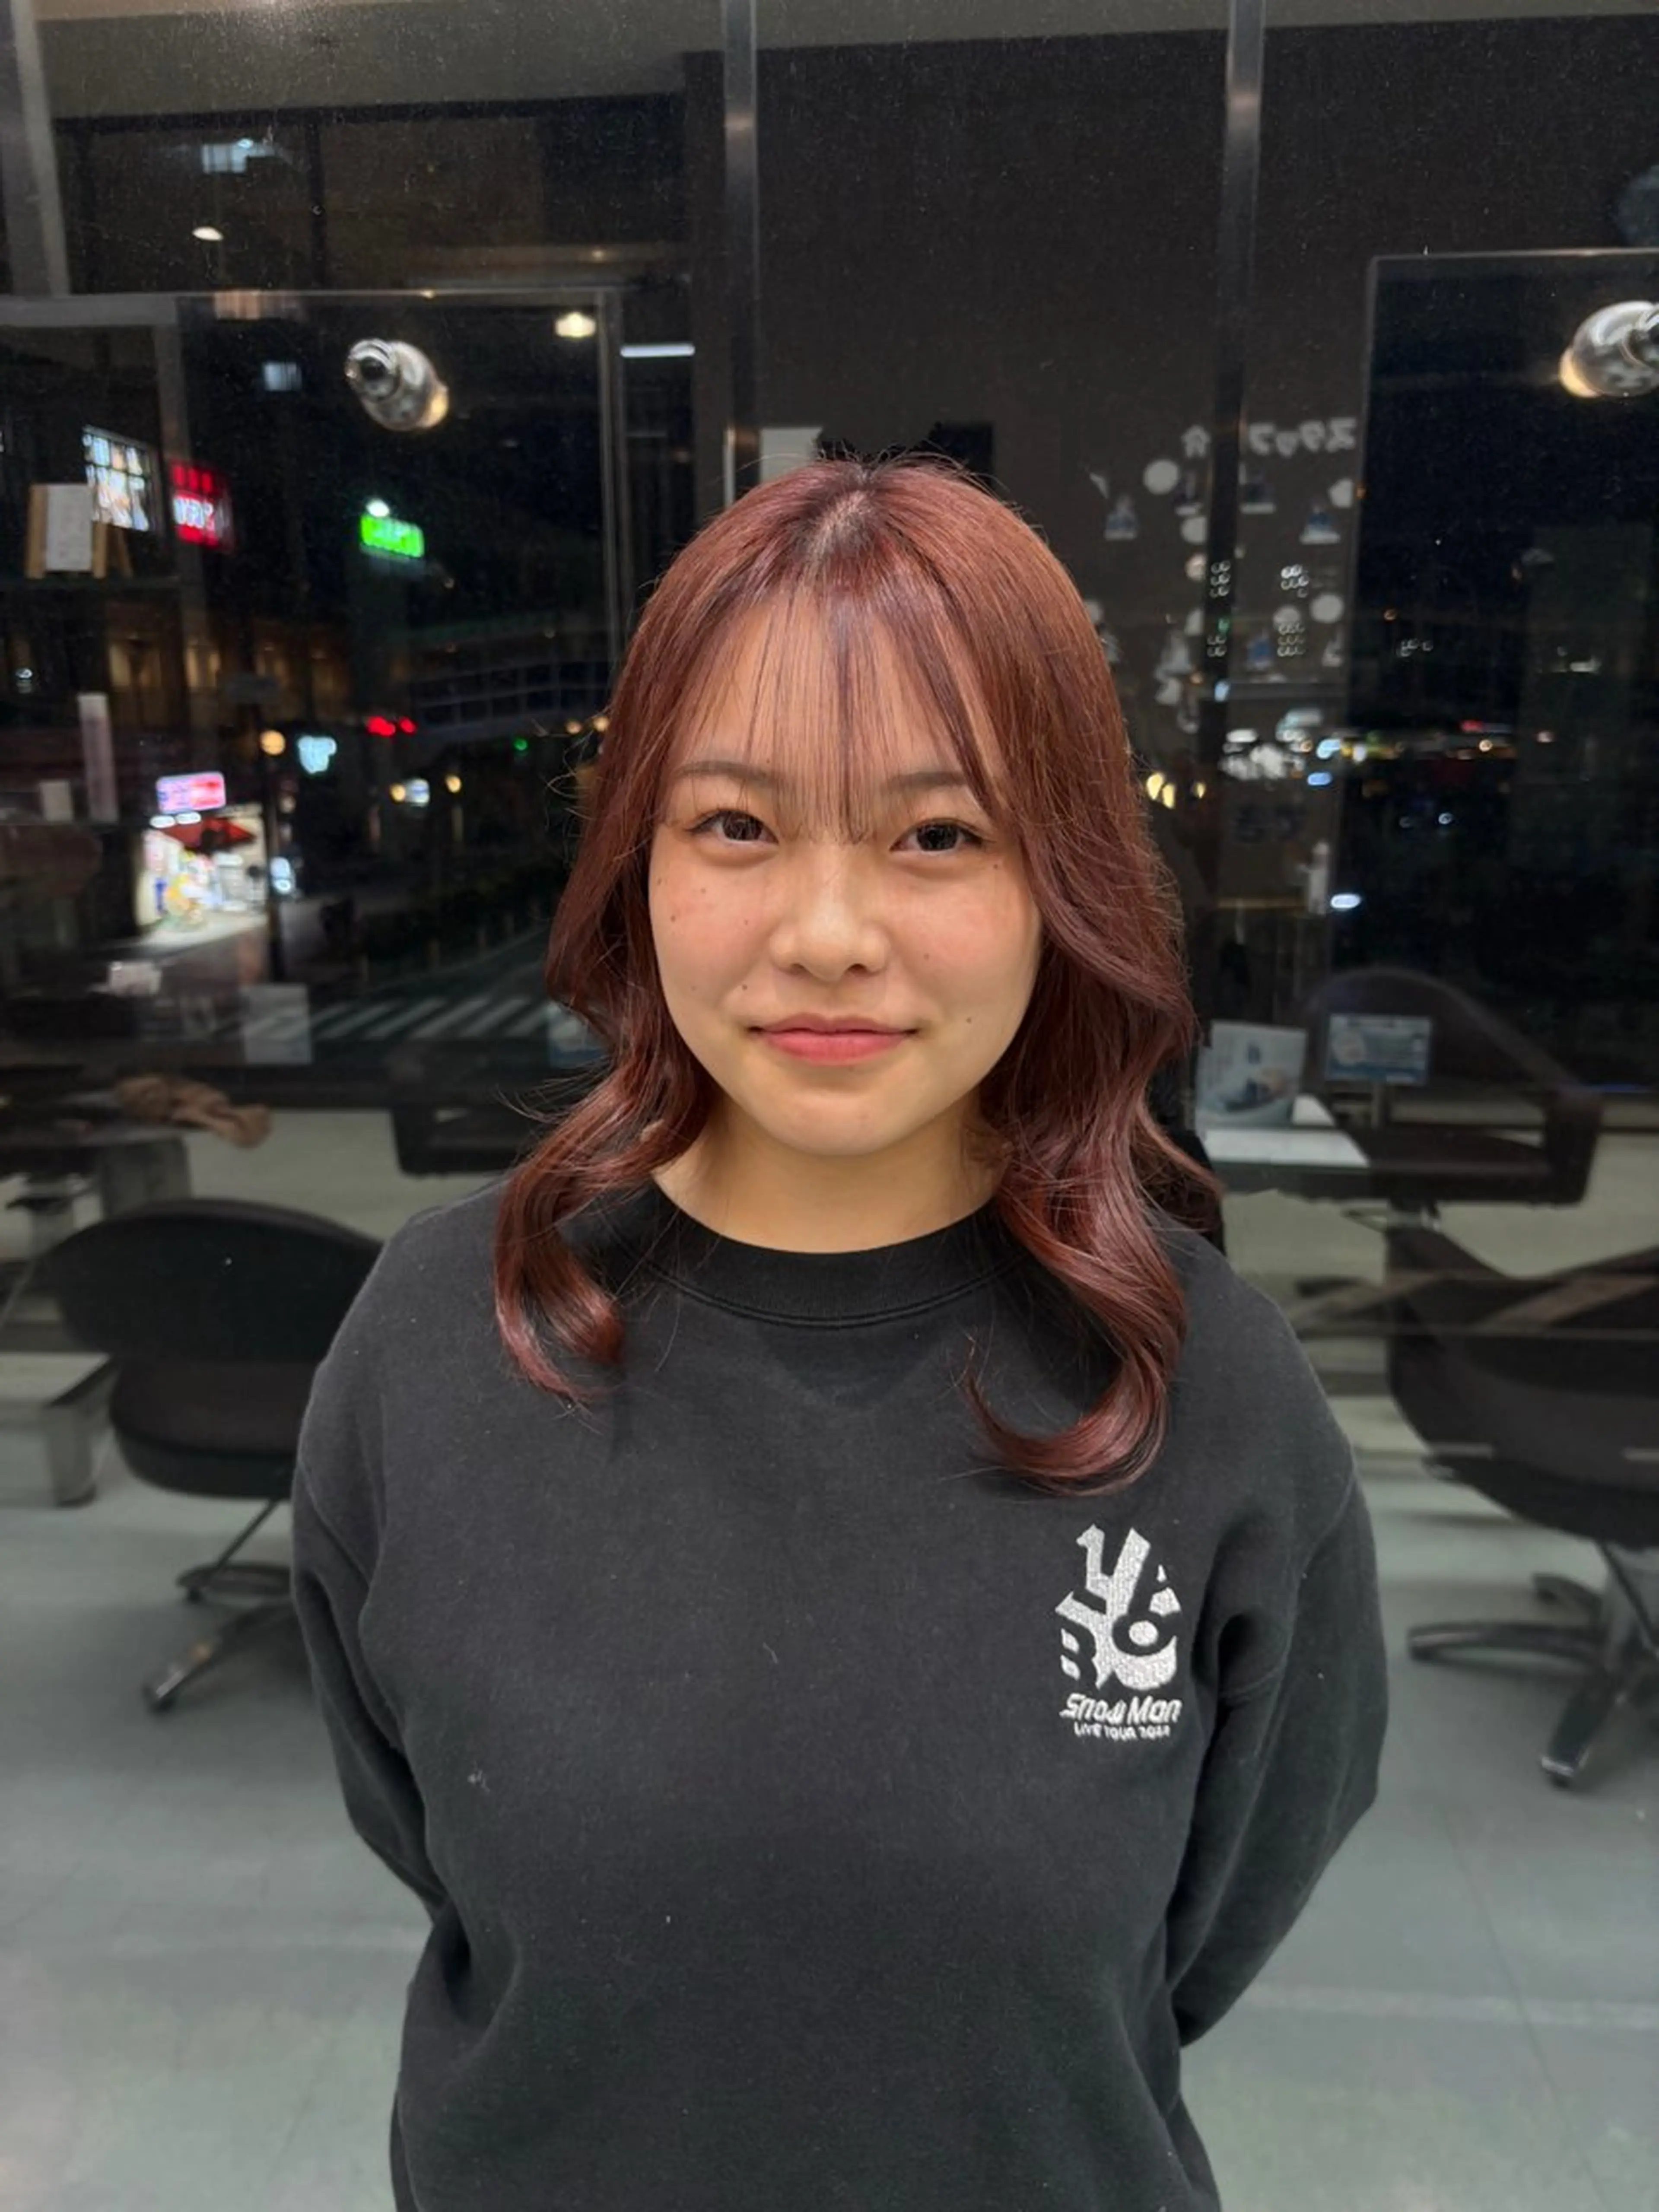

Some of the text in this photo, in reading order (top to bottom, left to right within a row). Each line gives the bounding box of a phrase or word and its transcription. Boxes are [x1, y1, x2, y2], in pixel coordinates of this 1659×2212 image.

[1059, 1693, 1127, 1725] Snow
[1074, 1721, 1102, 1738] LIVE
[1104, 1725, 1138, 1741] TOUR
